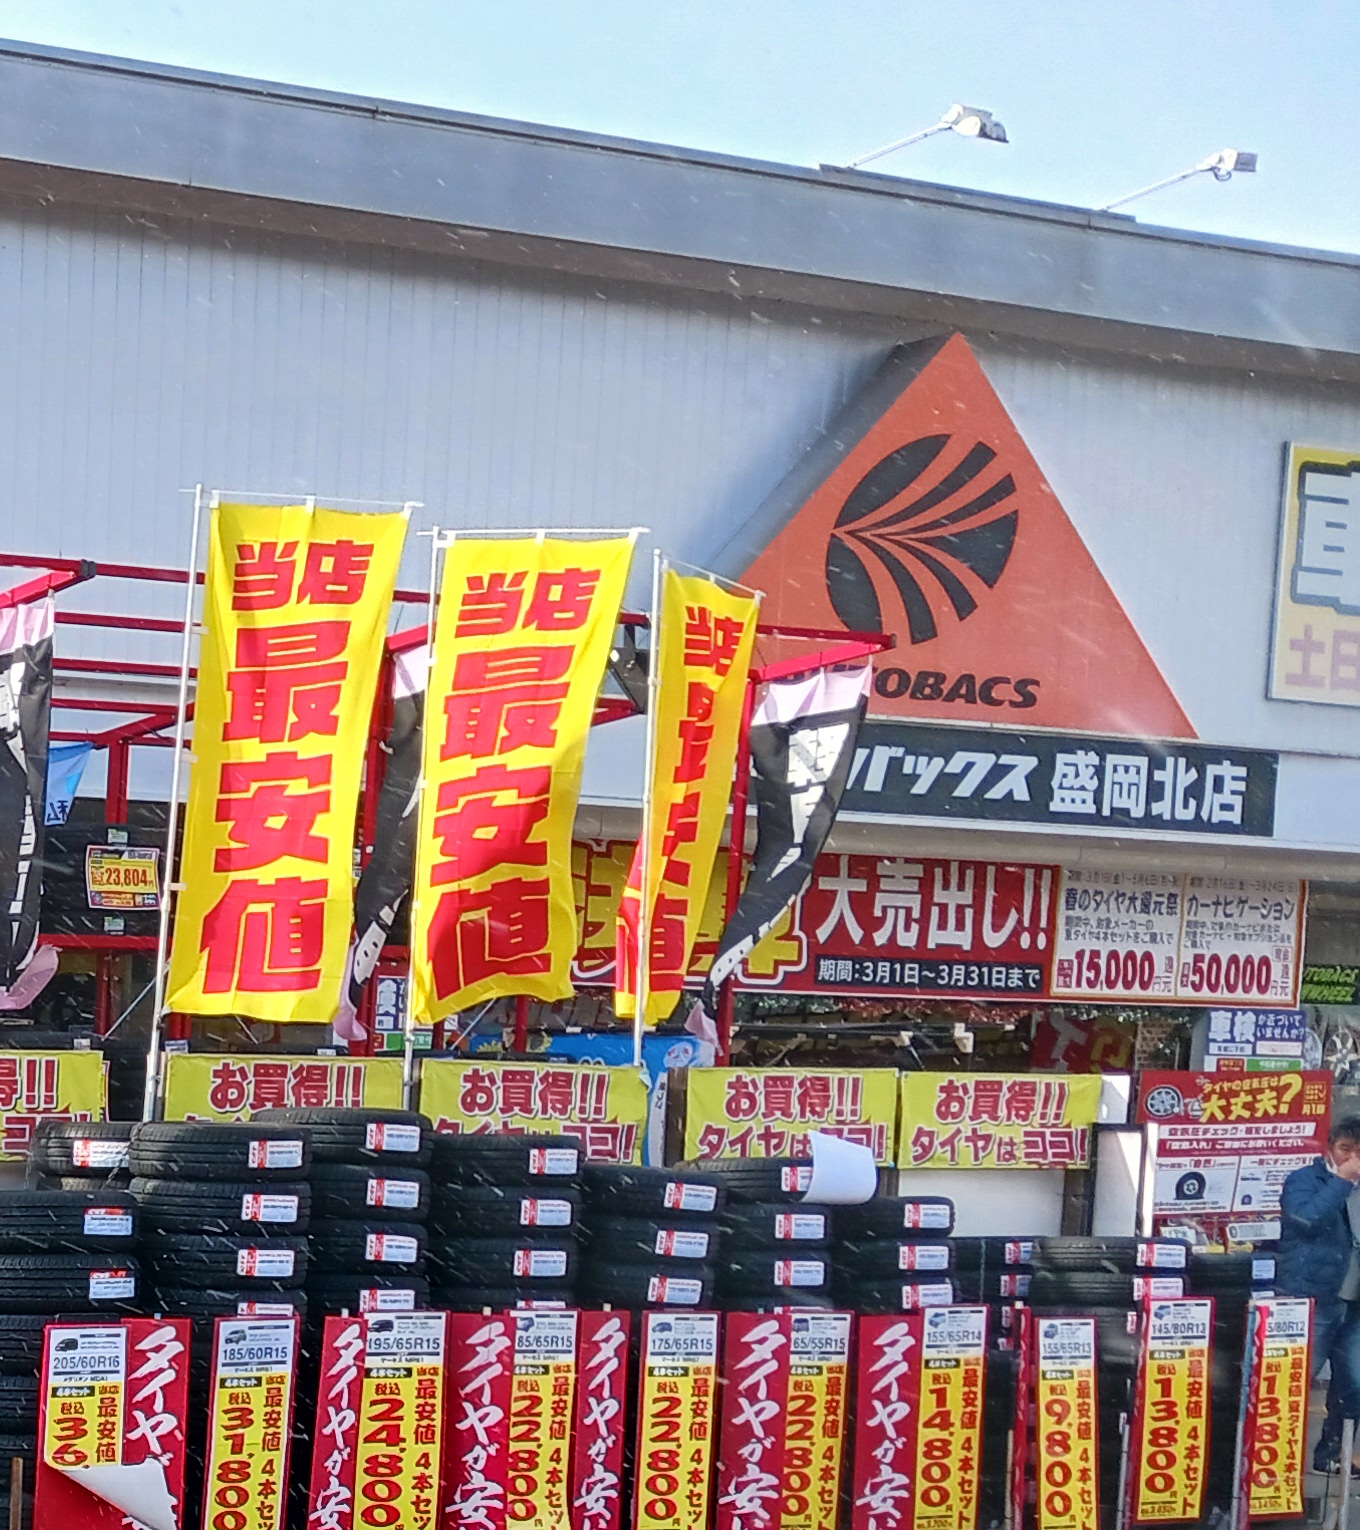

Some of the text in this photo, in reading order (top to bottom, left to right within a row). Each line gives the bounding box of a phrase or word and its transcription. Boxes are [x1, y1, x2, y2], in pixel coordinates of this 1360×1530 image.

[232, 540, 374, 610] 当店
[454, 568, 600, 639] 当店
[199, 620, 351, 995] 最安値
[1050, 750, 1247, 825] 盛岡北店
[427, 644, 575, 1001] 最安値
[814, 853, 1050, 950] 大売出し!!
[1065, 887, 1179, 915] 春のタイヤ大還元祭
[1186, 894, 1296, 920] カーナビゲーション
[1209, 1010, 1256, 1042] 車検
[1256, 1026, 1305, 1040] いませんか?
[1258, 1013, 1303, 1027] が近づいて
[211, 1061, 364, 1111] お買得!!
[460, 1066, 610, 1120] お買得!!
[724, 1073, 863, 1122] お買得!!
[935, 1078, 1068, 1124] お買得!!
[910, 1125, 1089, 1165] タイヤはココ!
[53, 1355, 120, 1370] 205/60R16
[222, 1346, 288, 1361] 185/60R15
[367, 1336, 441, 1352] 195/65R15
[517, 1334, 573, 1348] 85/65R15
[650, 1336, 713, 1351] 175/65R15
[793, 1336, 846, 1350] 65/55R15
[414, 1379, 437, 1446] 最安値
[549, 1375, 570, 1440] 最安値
[688, 1378, 710, 1442] 最安値
[821, 1376, 842, 1440] 最安値
[960, 1367, 980, 1430] 最安値
[1076, 1380, 1092, 1441] 最安値
[1185, 1359, 1205, 1420] 最安値
[96, 1397, 118, 1464] 最安値
[261, 1387, 283, 1452] 最安値
